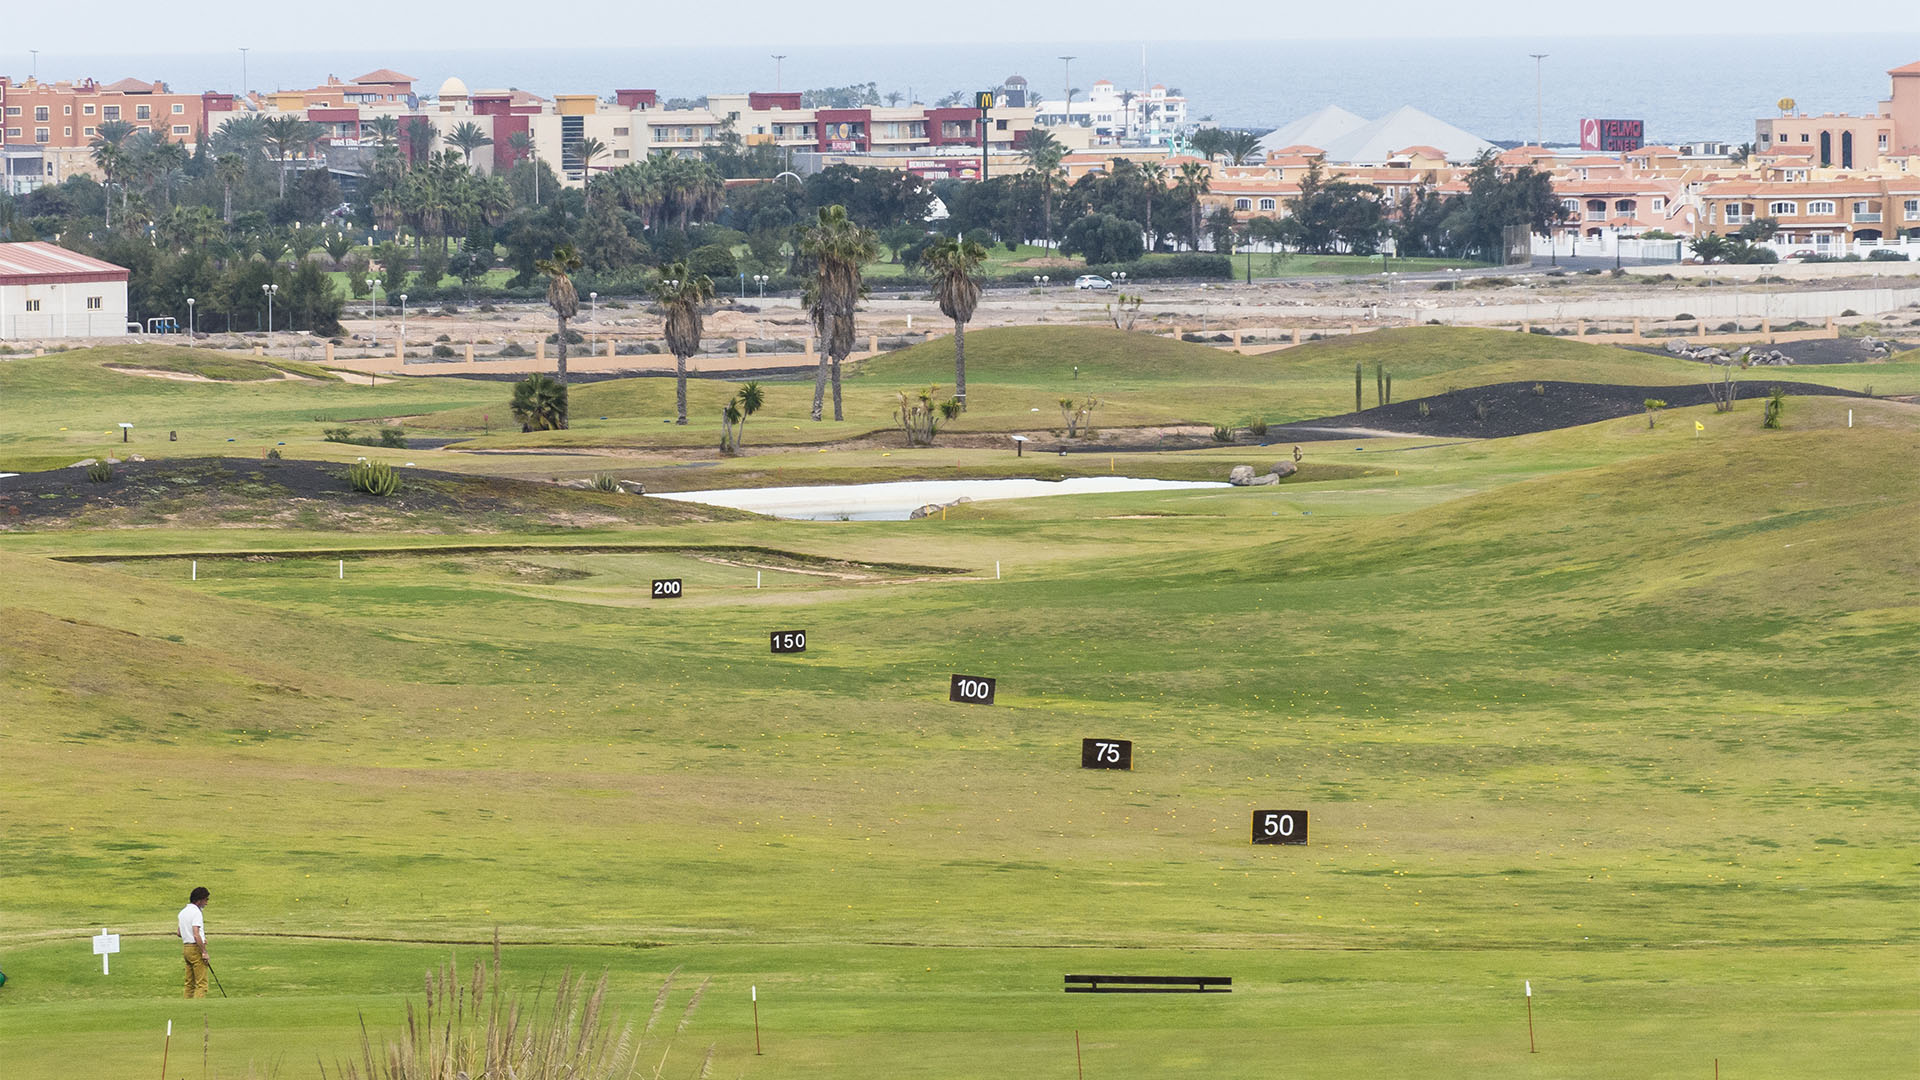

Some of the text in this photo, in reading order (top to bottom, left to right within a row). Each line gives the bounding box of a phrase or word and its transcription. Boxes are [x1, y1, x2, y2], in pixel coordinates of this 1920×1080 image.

[1604, 120, 1640, 137] YELMO
[1607, 139, 1637, 151] CINES
[653, 581, 681, 594] 200
[773, 633, 805, 650] 150
[957, 679, 989, 699] 100
[1095, 742, 1120, 763] 75
[1264, 814, 1294, 837] 50
